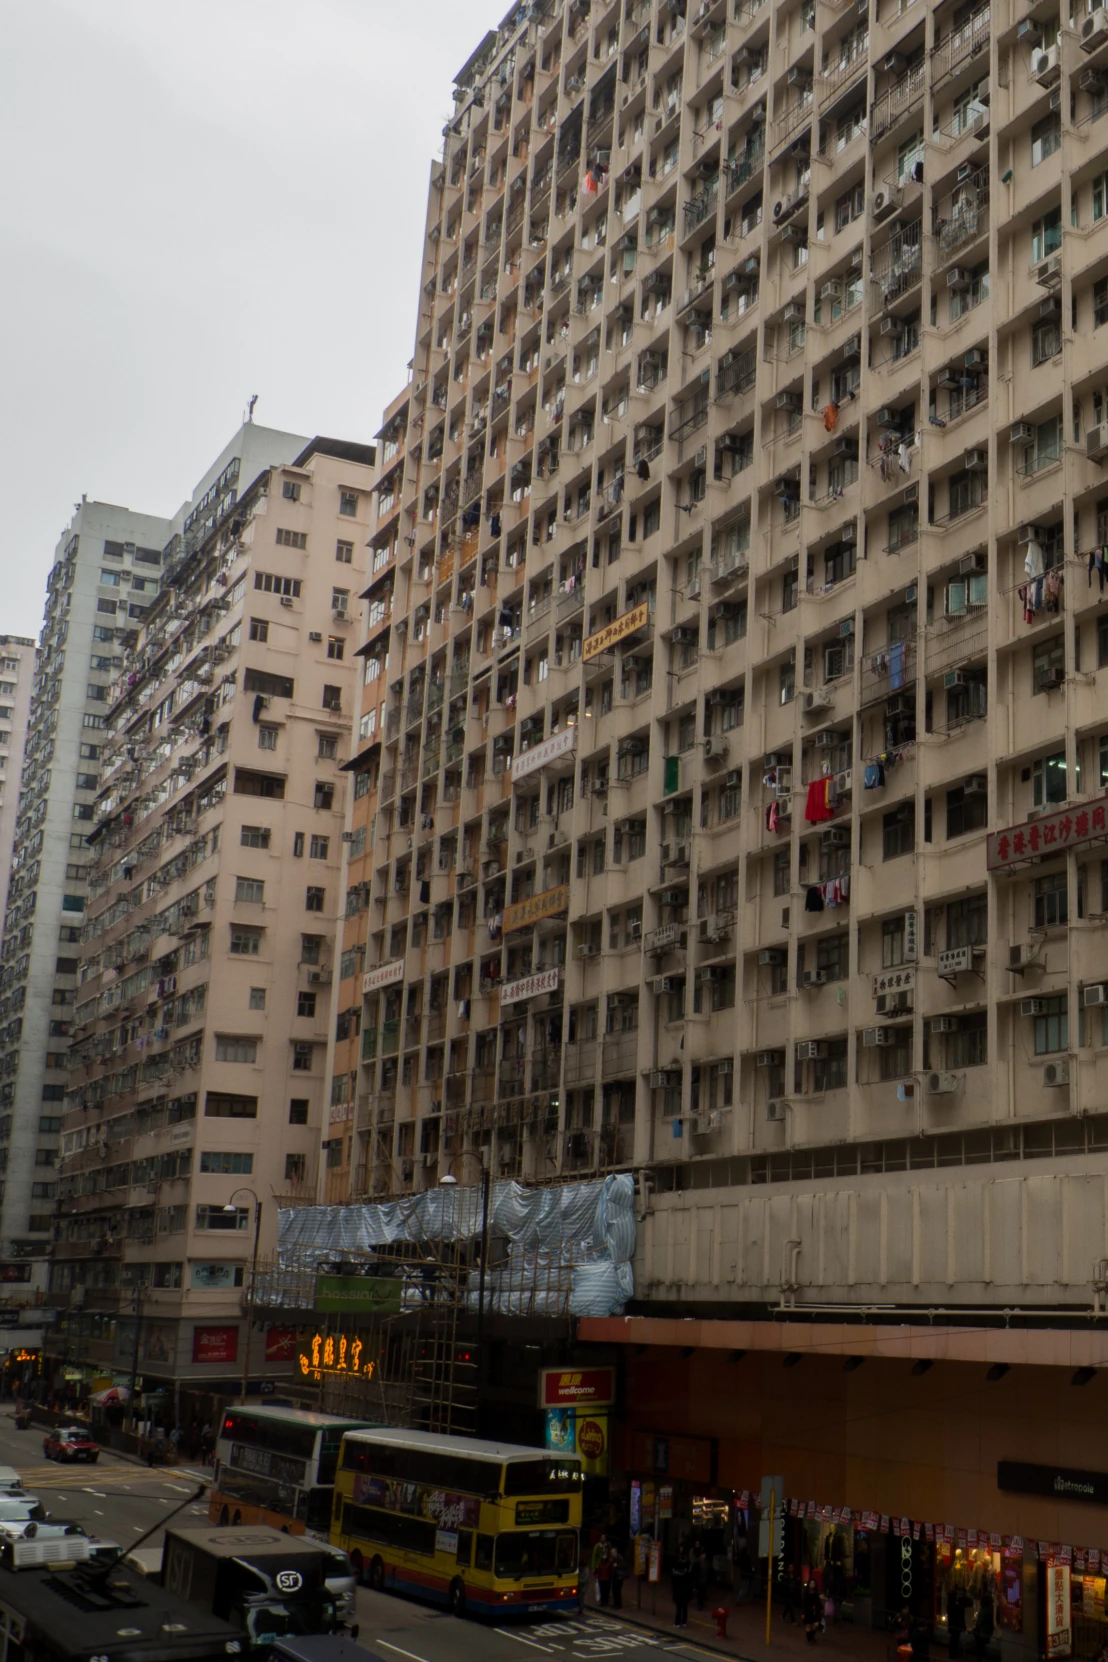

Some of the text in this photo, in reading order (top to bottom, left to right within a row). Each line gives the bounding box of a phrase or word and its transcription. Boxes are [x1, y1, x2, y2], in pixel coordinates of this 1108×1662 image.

[558, 1386, 596, 1395] wellcome
[281, 1574, 297, 1587] SF
[572, 1633, 659, 1651] BUS
